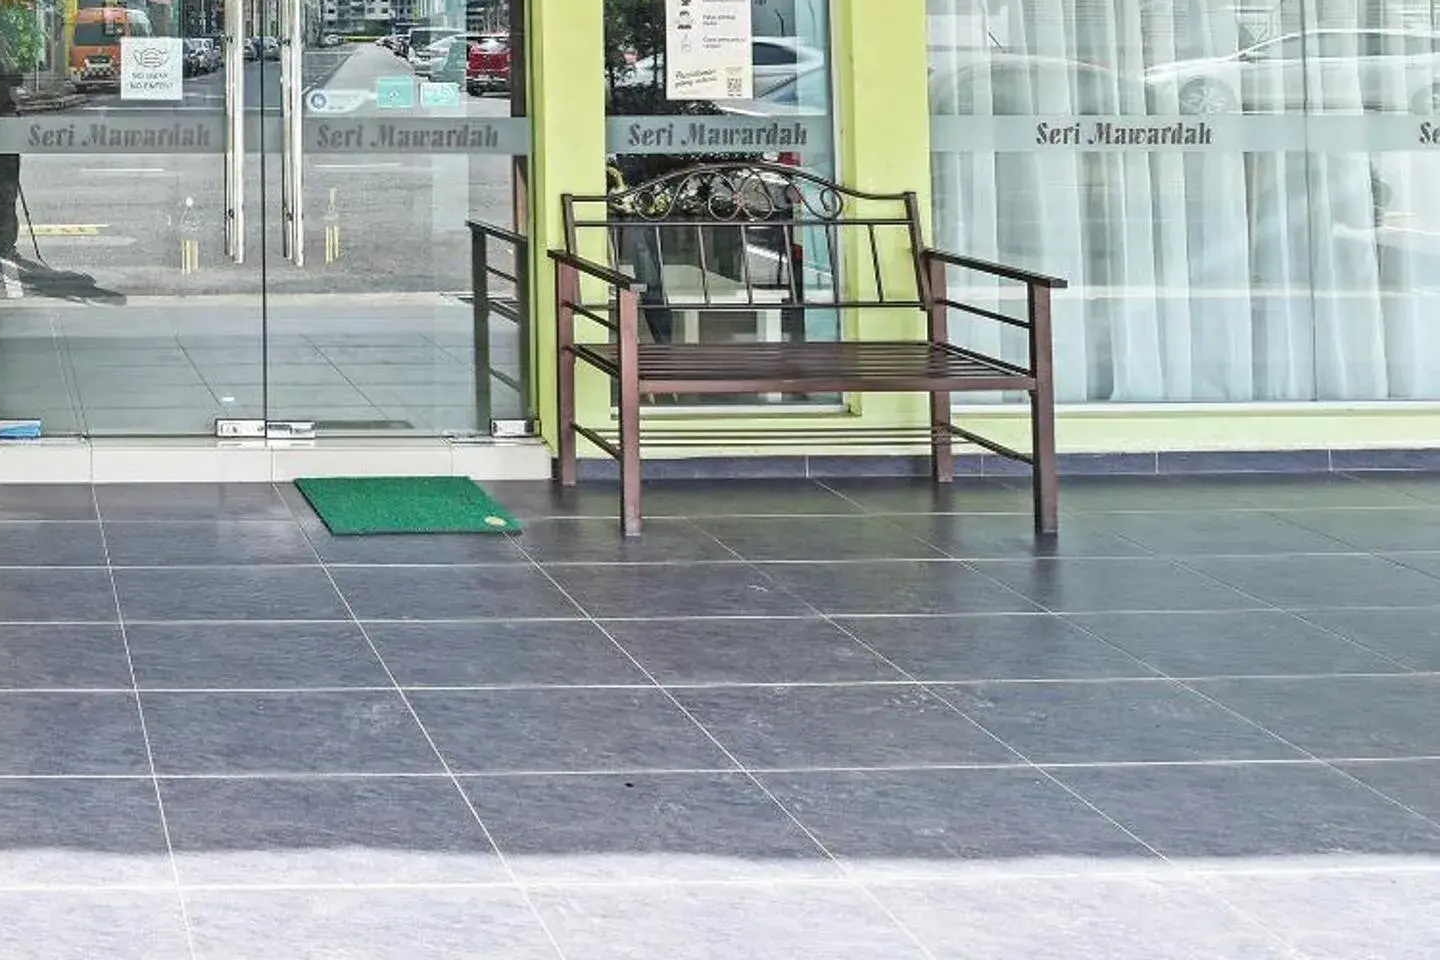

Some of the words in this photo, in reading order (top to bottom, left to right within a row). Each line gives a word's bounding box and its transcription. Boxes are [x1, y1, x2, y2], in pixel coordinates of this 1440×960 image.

[28, 124, 75, 148] Seri
[82, 124, 210, 148] Mawardah
[316, 124, 364, 148] Seri
[370, 124, 498, 148] Mawardah
[628, 122, 674, 147] Seri
[680, 122, 807, 146] Mawardah
[1036, 122, 1080, 145] Seri
[1087, 122, 1212, 145] Mawardah
